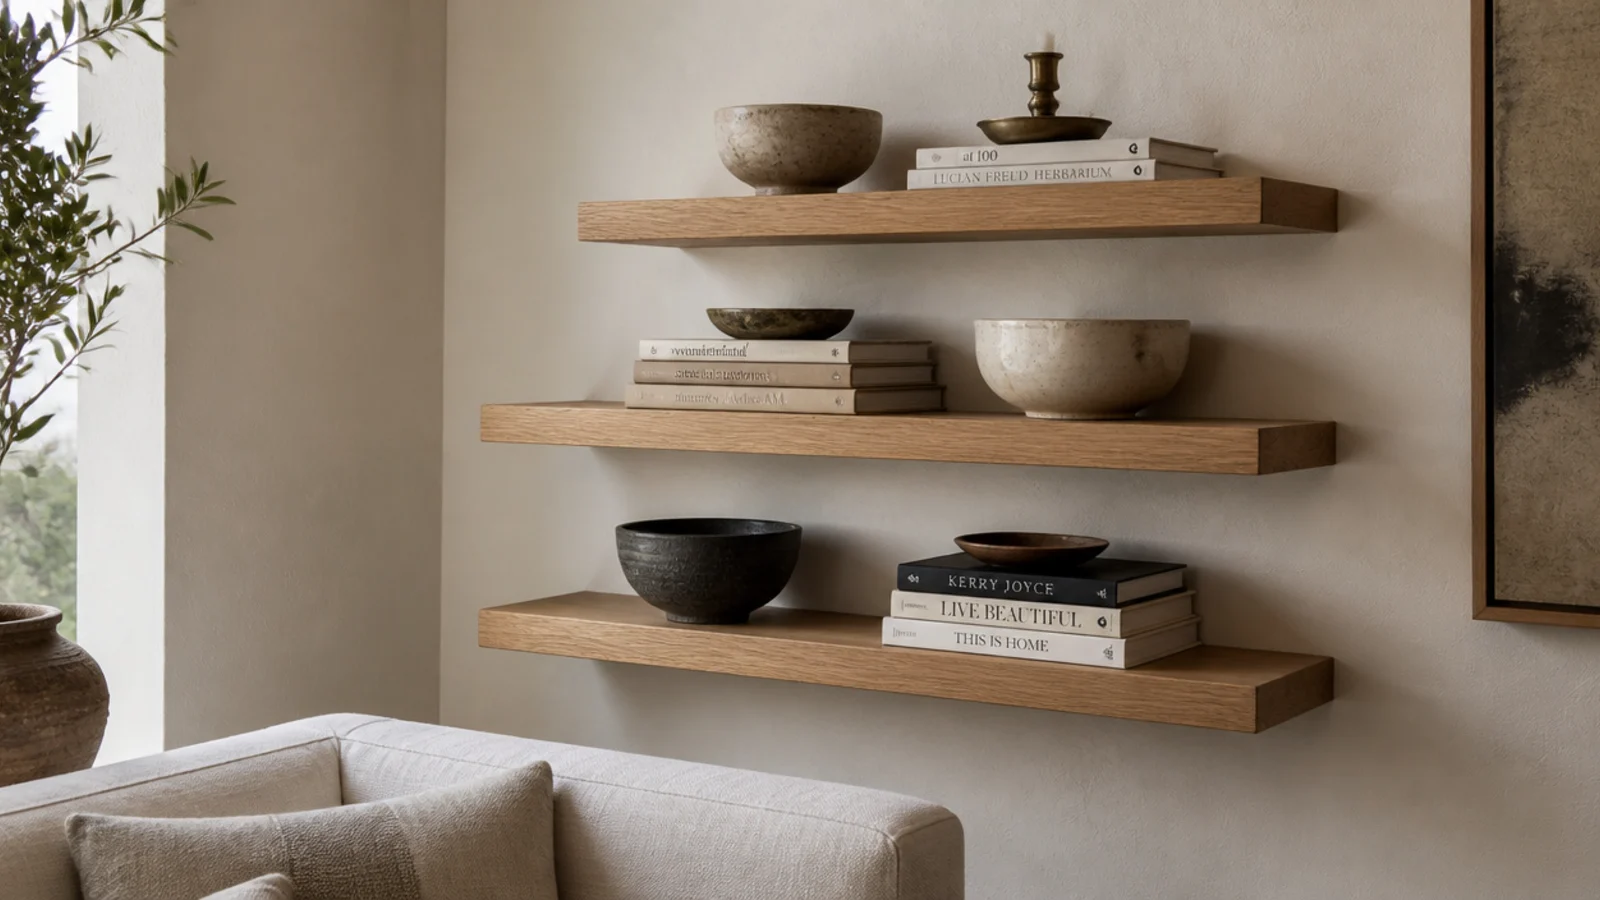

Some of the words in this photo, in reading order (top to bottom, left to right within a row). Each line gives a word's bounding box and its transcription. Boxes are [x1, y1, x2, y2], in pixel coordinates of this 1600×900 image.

[933, 172, 981, 185] LUCIAN
[1034, 166, 1112, 181] HERBARIUM
[948, 574, 998, 591] KERRY
[1003, 579, 1054, 597] JOYCE
[941, 600, 980, 619] LIVE
[984, 603, 1082, 629] BEAUTIFUL
[954, 631, 986, 647] THIS
[990, 634, 1002, 648] IS
[1006, 636, 1050, 653] HOME
